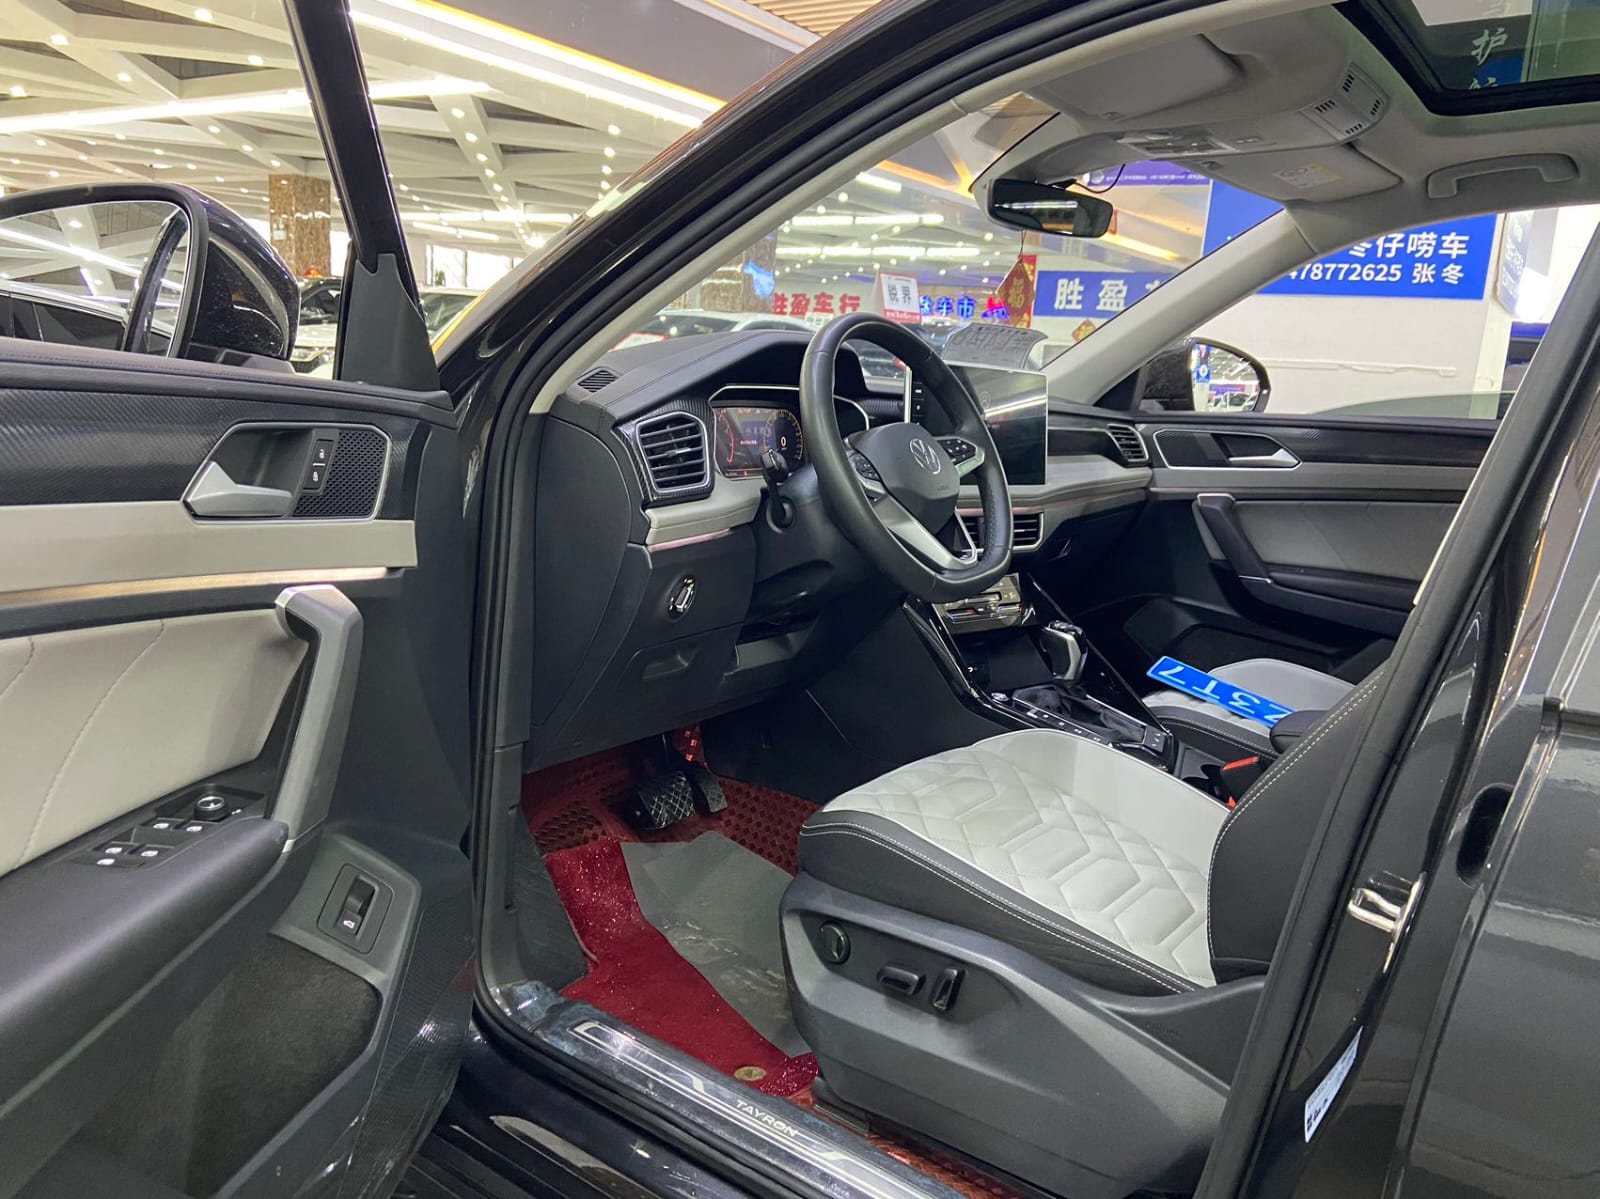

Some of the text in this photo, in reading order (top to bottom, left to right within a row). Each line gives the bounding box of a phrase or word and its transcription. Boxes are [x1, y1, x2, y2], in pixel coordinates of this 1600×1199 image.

[1412, 263, 1465, 285] 张冬
[1054, 278, 1161, 312] 胜盈
[736, 1098, 799, 1138] TAYRON
